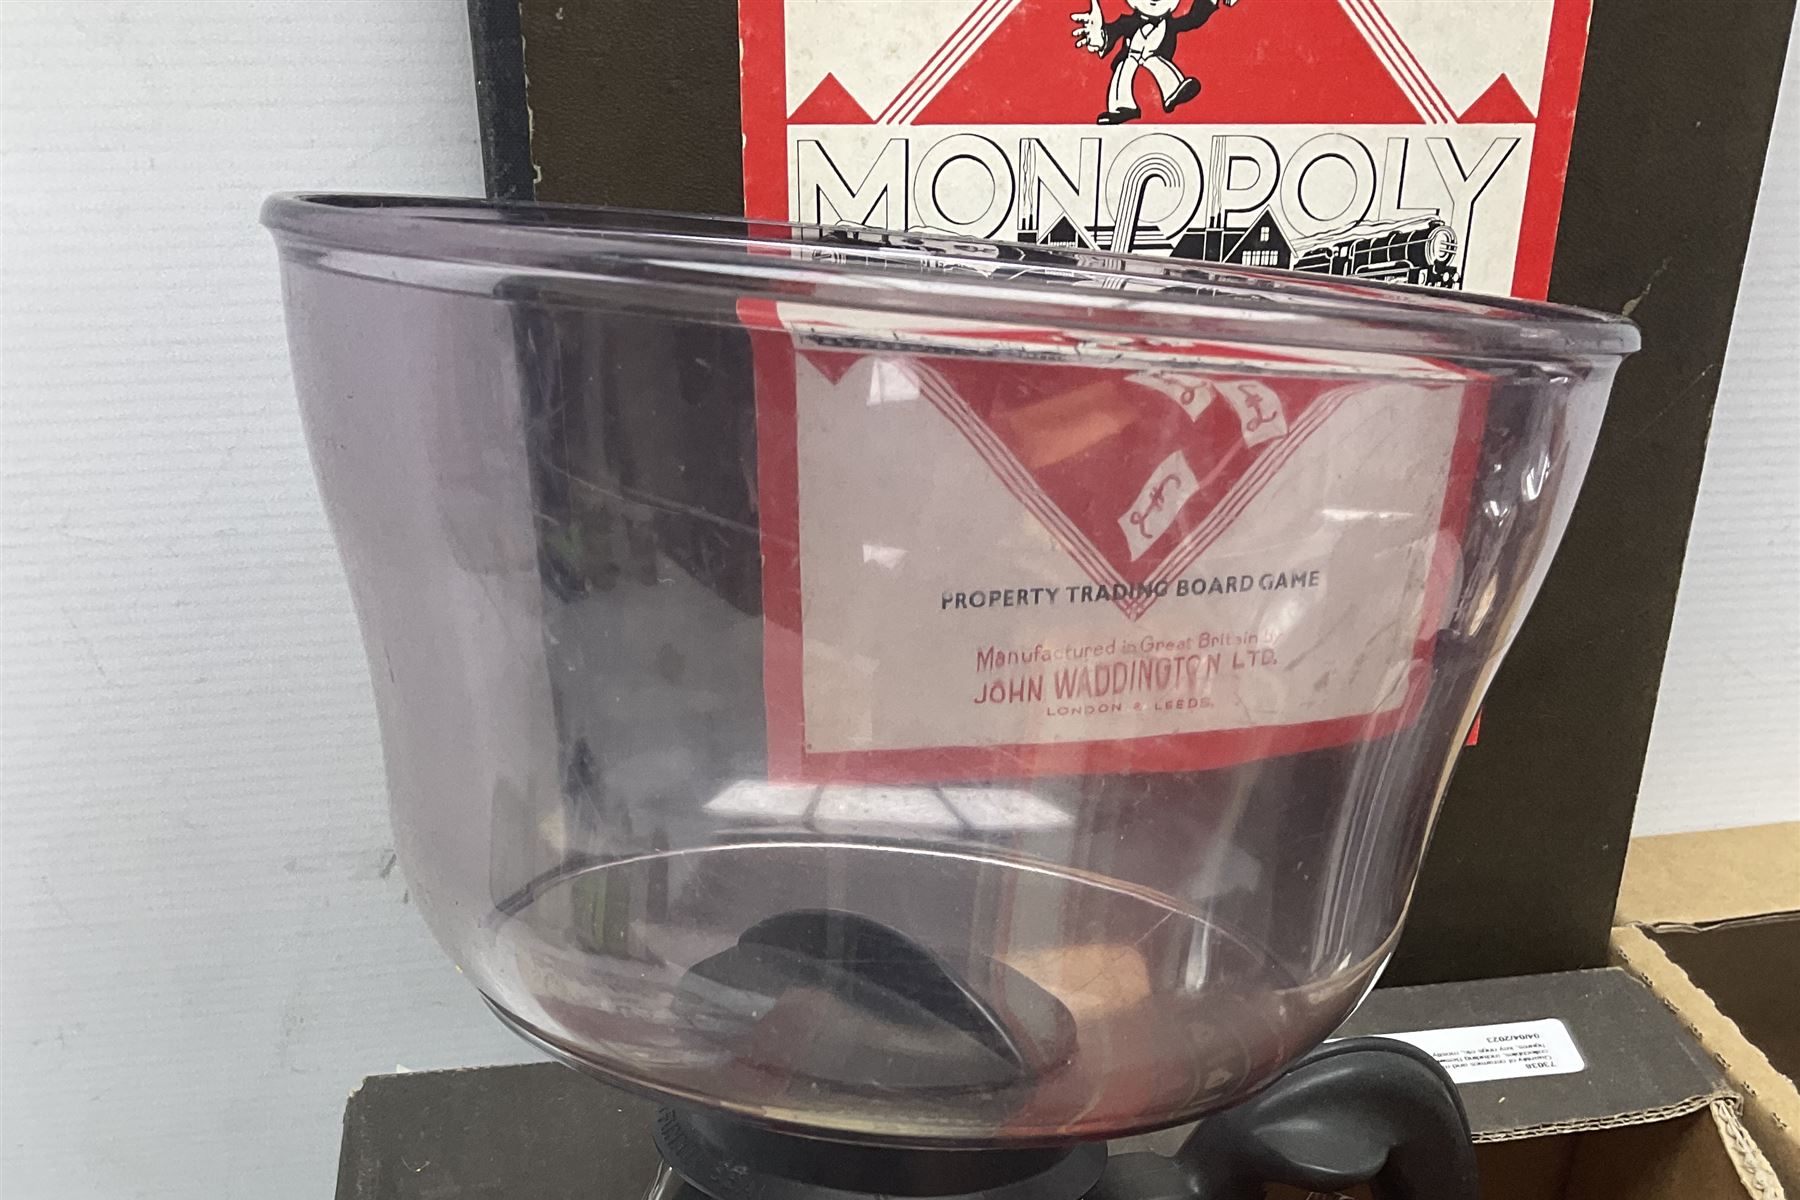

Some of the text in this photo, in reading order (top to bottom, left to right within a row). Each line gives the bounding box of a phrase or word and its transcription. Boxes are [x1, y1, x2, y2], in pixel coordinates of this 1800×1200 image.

[796, 132, 1522, 250] MONOPOLY
[940, 569, 1321, 610] PROPERTY TRADING BOARD GAME
[976, 639, 1117, 673] Manufactured
[1121, 638, 1138, 654] in
[1139, 634, 1193, 653] Great
[1198, 629, 1259, 650] Britain
[973, 673, 1044, 705] JOHN
[1053, 652, 1222, 701] WADDINGTON
[1046, 702, 1123, 717] LONDON
